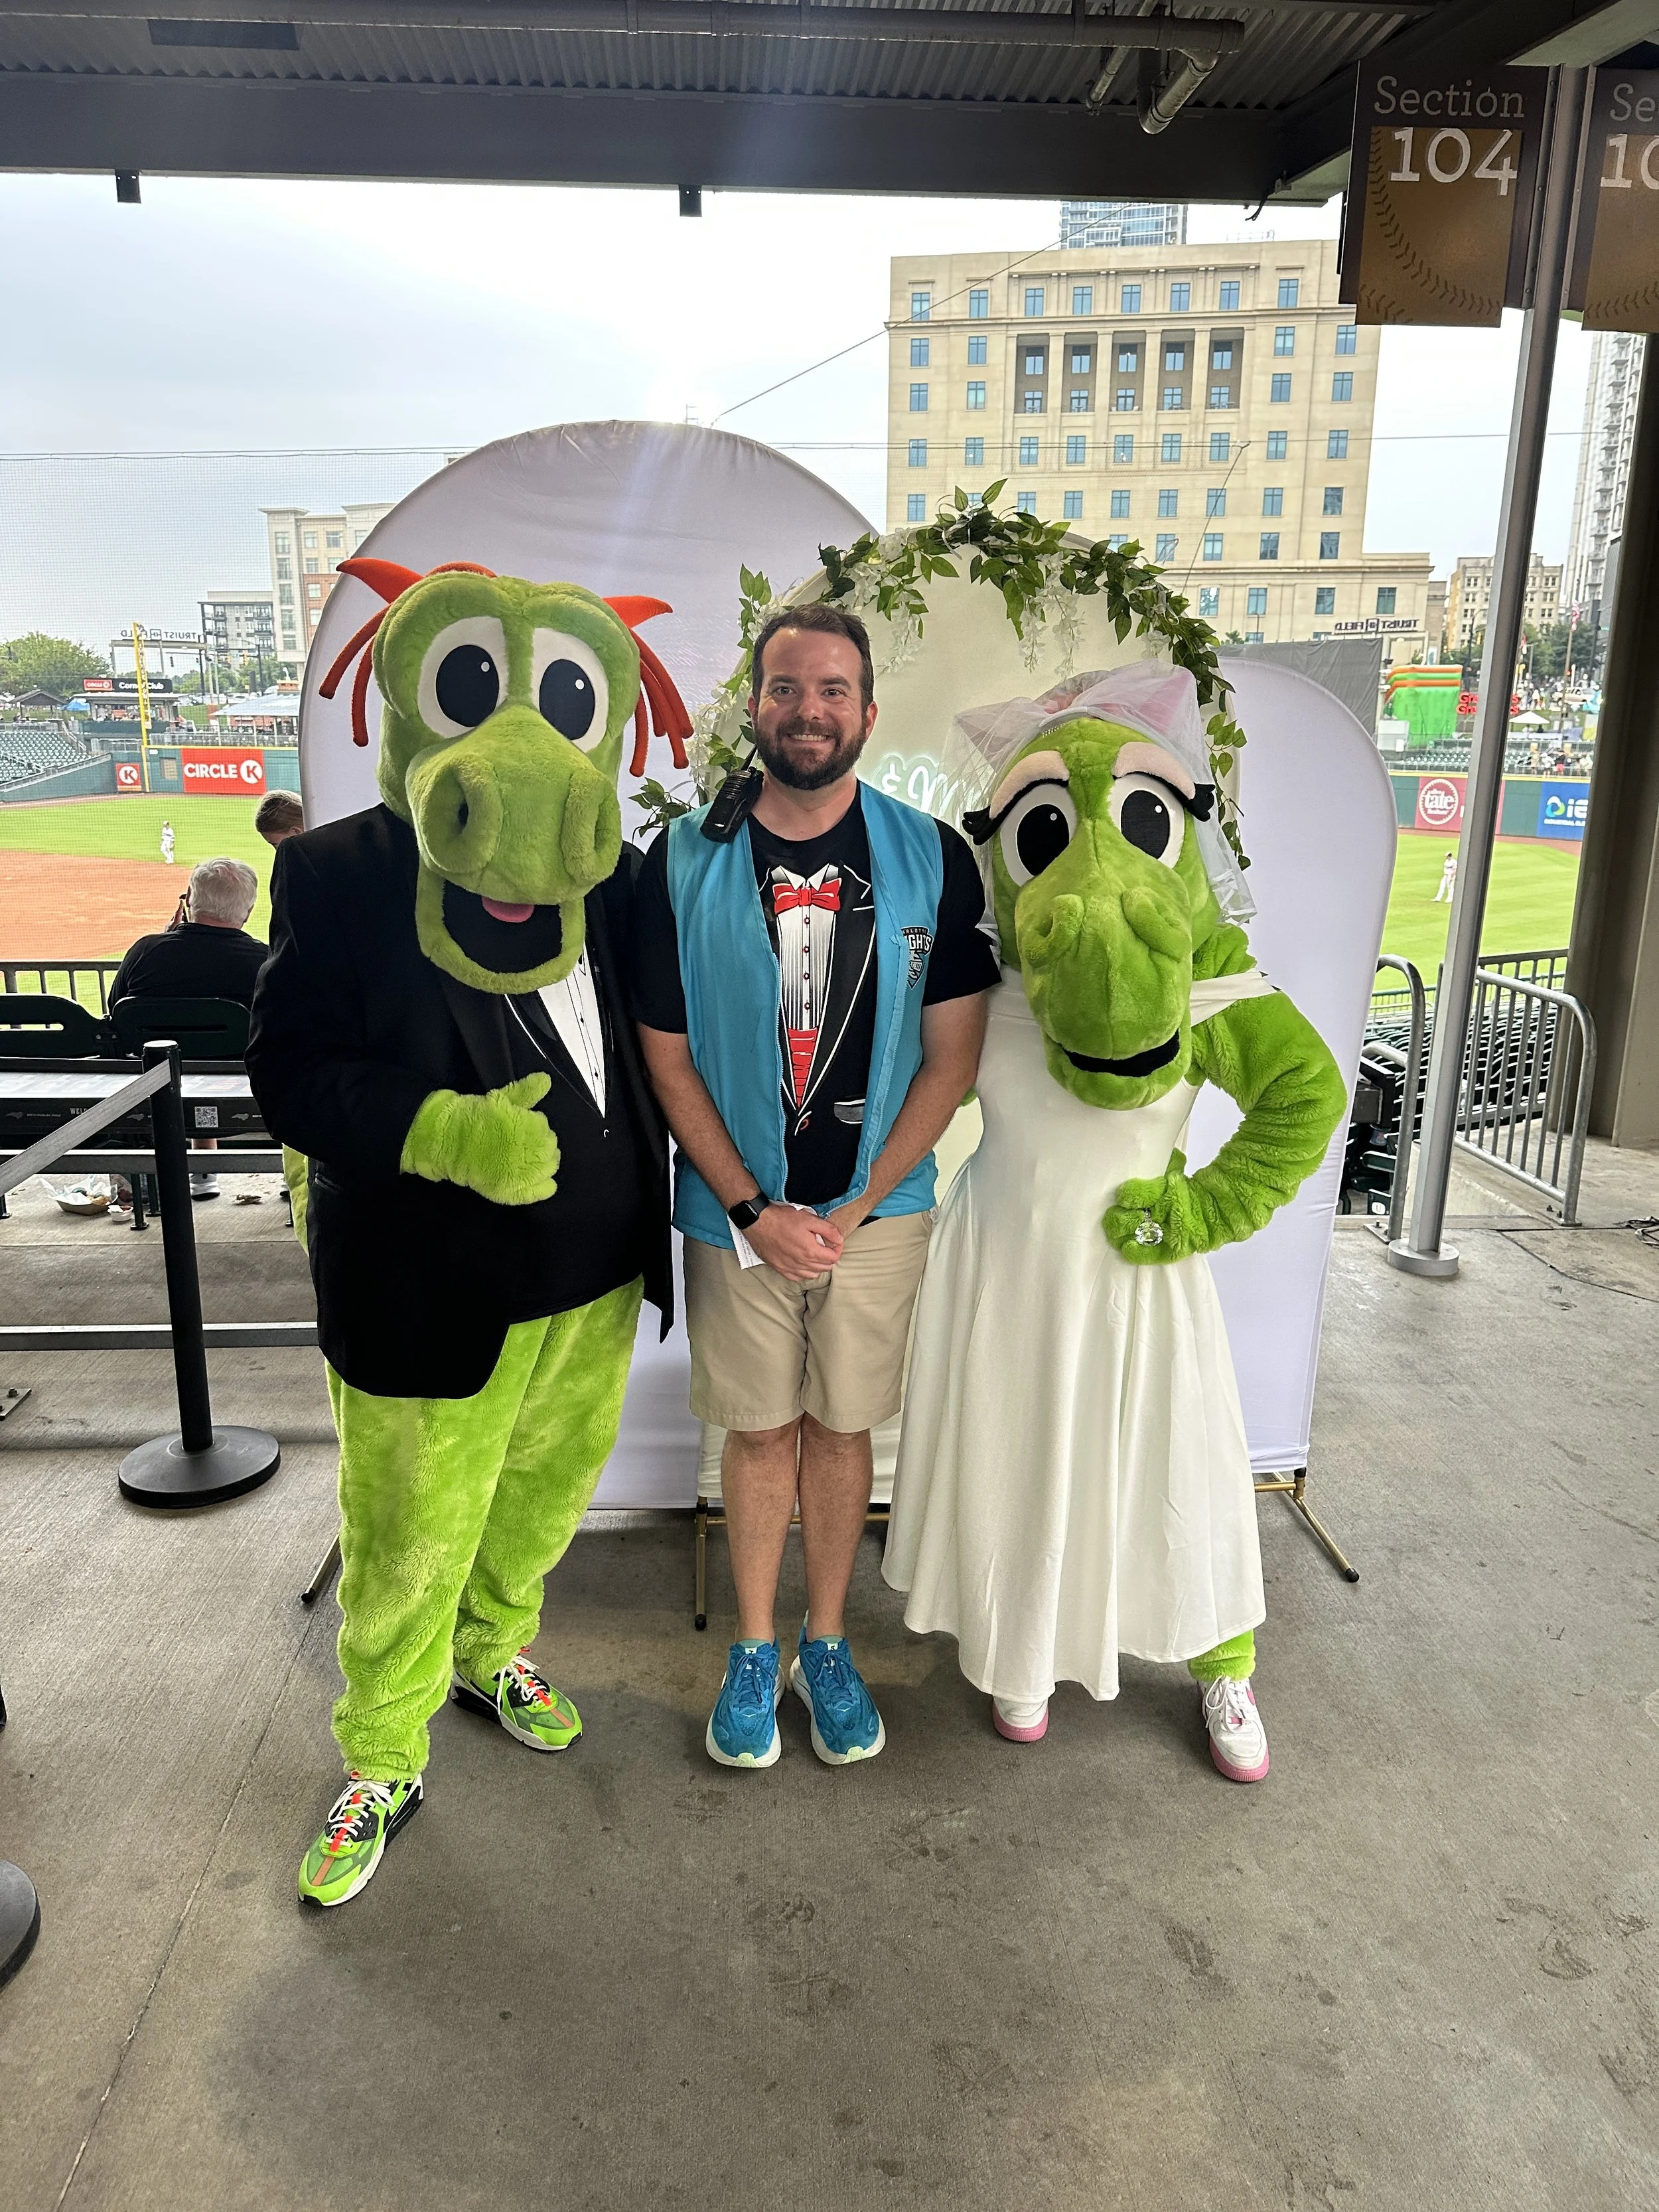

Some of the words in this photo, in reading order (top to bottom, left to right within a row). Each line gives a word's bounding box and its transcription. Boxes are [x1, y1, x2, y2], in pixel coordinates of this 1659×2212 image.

[1374, 75, 1524, 118] Section
[1390, 127, 1518, 196] 104
[122, 768, 137, 782] K
[183, 763, 238, 778] CIRCLE
[245, 763, 262, 782] K
[904, 934, 932, 951] GHTS
